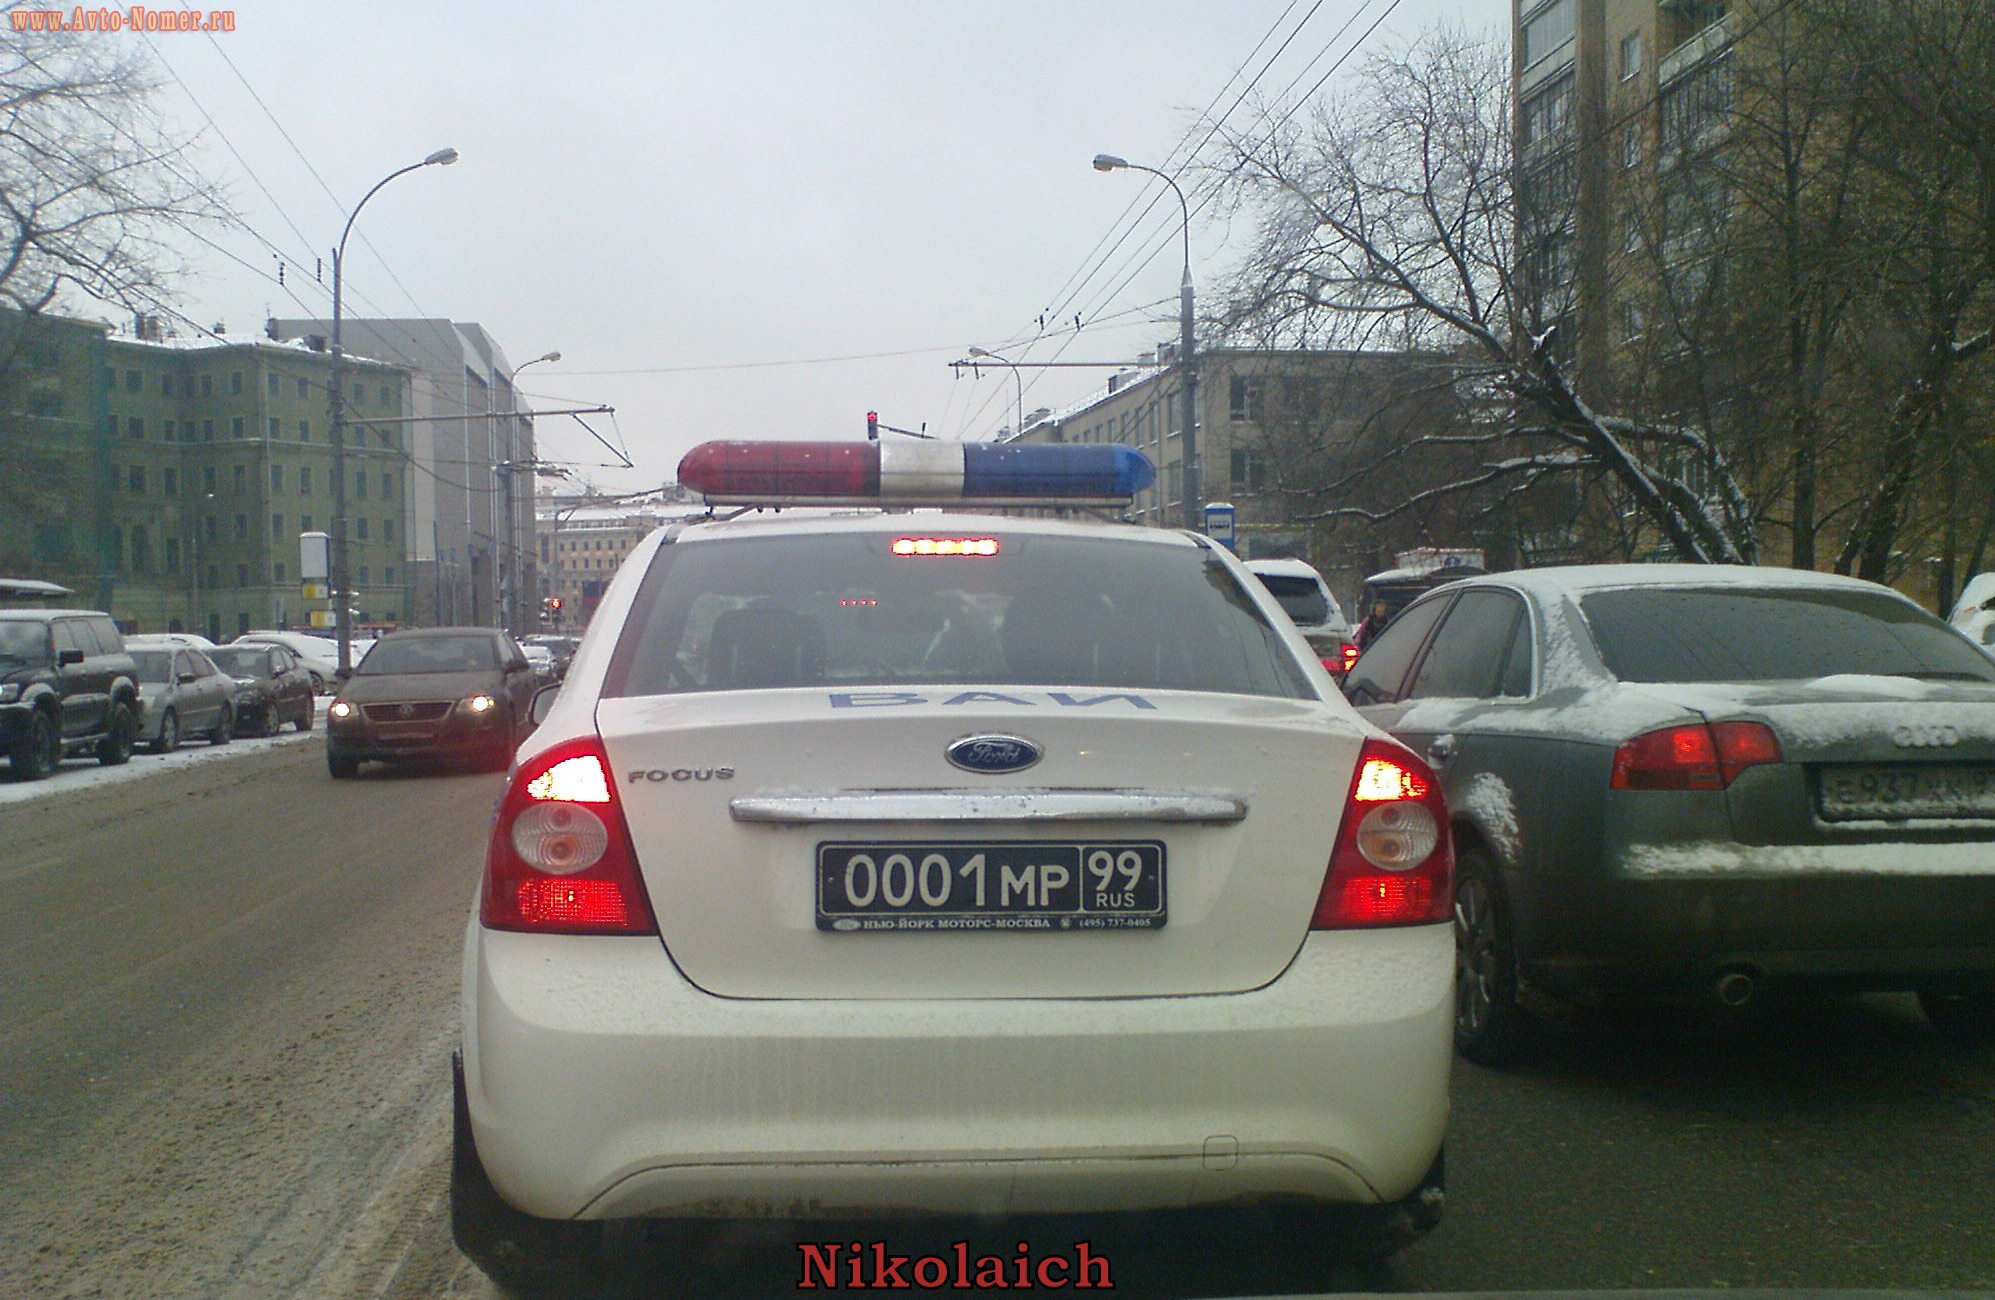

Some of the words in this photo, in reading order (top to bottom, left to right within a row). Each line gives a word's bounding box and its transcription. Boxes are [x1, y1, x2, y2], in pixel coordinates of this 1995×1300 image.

[967, 741, 1021, 763] Ford
[628, 767, 735, 784] FOCUS
[1087, 850, 1143, 892] 99
[1096, 893, 1136, 908] RUS
